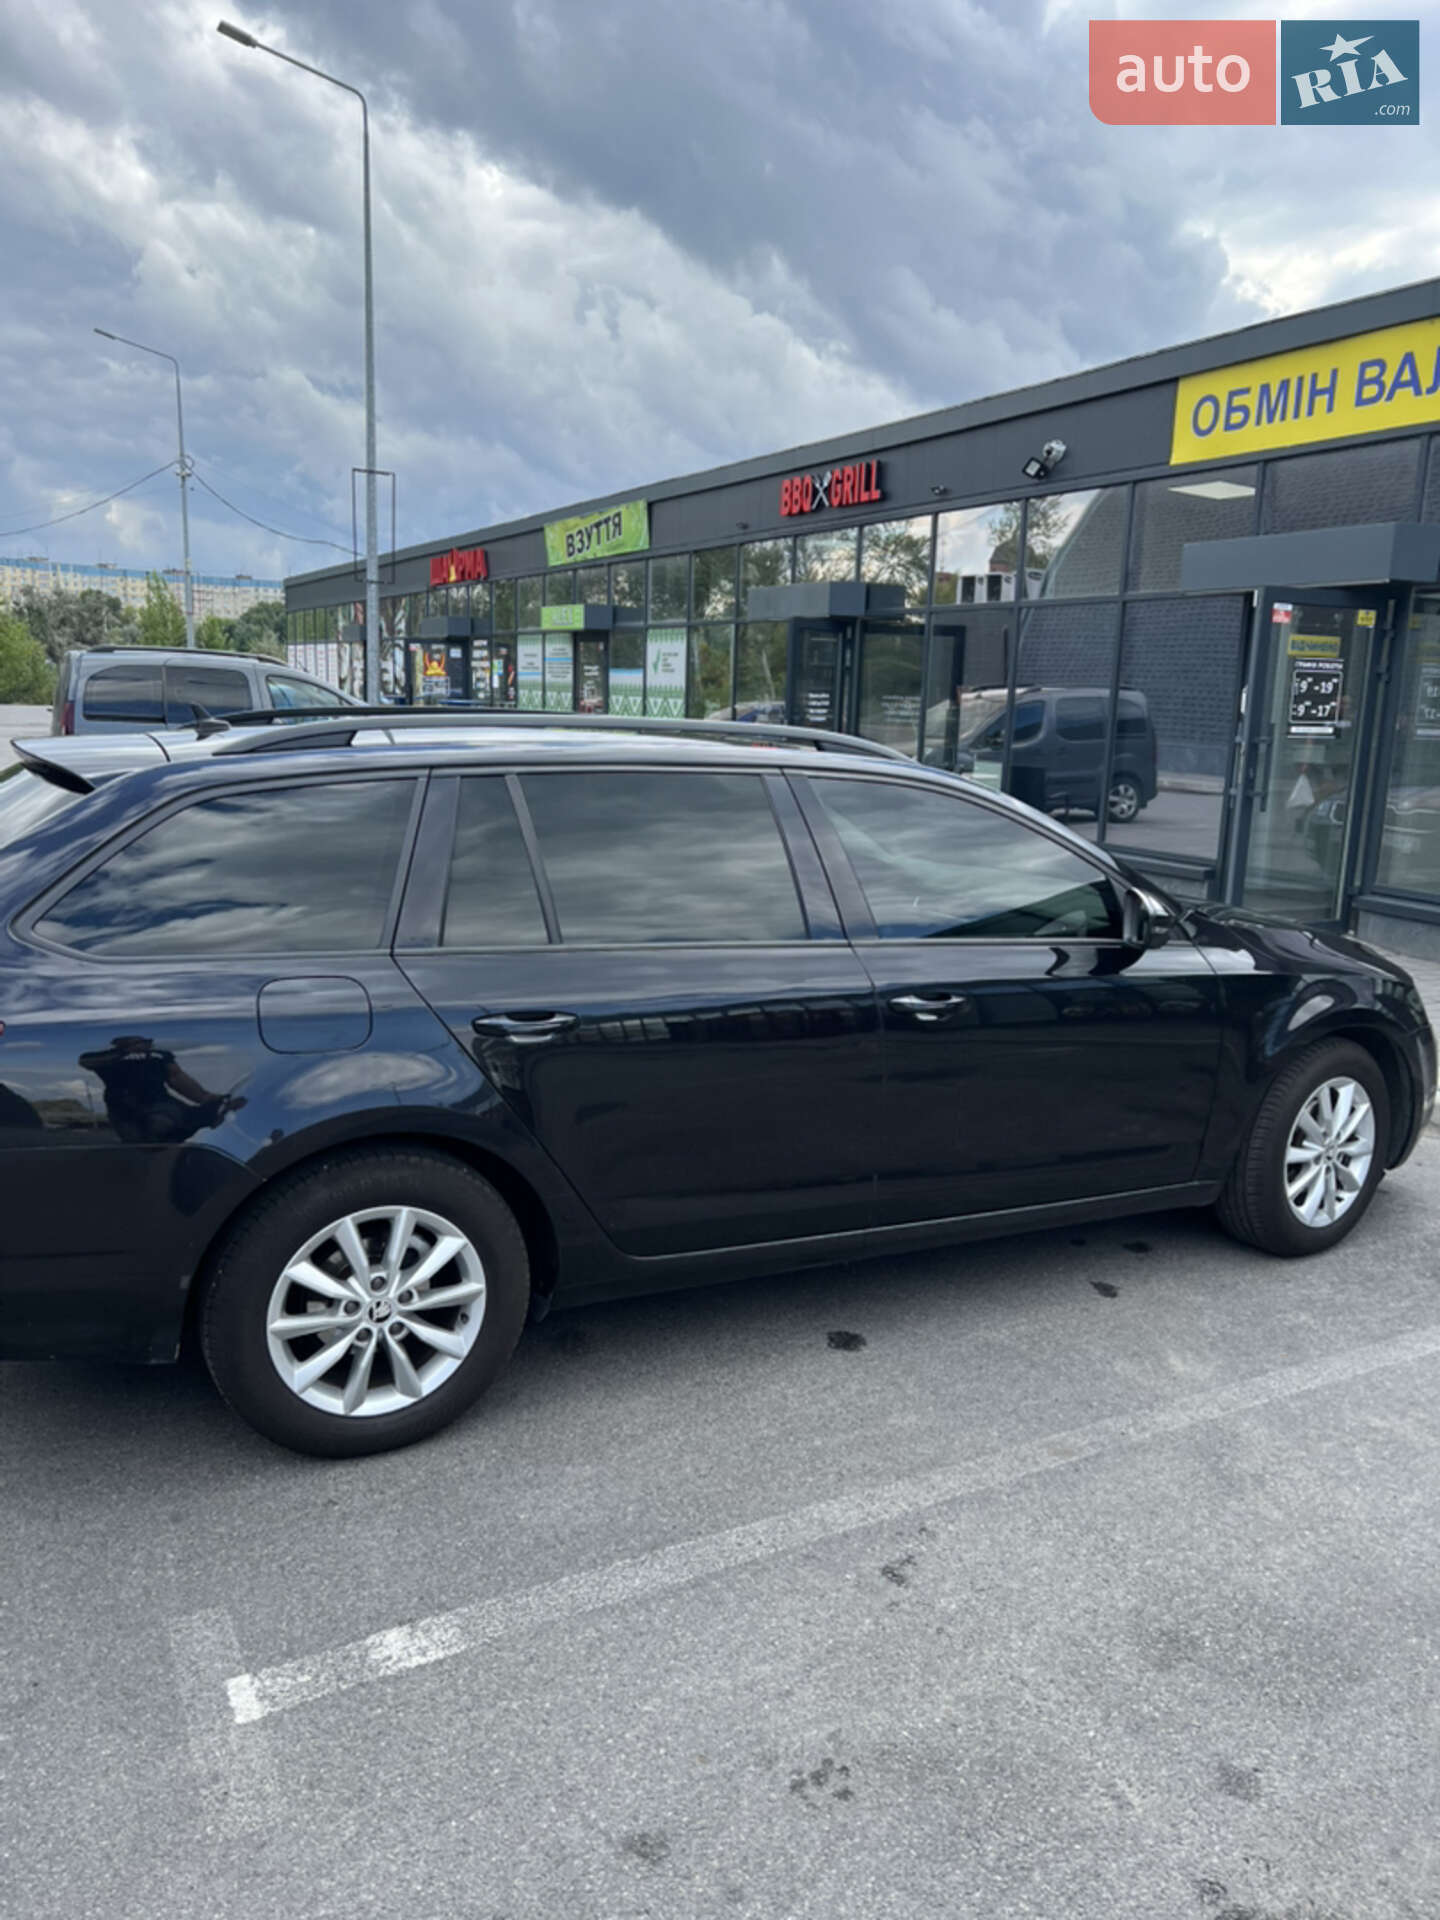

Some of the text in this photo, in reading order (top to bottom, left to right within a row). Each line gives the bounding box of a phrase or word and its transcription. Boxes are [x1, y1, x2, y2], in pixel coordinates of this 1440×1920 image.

[1191, 368, 1339, 438] ОБМІН
[831, 459, 881, 508] GRILL
[565, 511, 622, 558] ВЗУТТЯ
